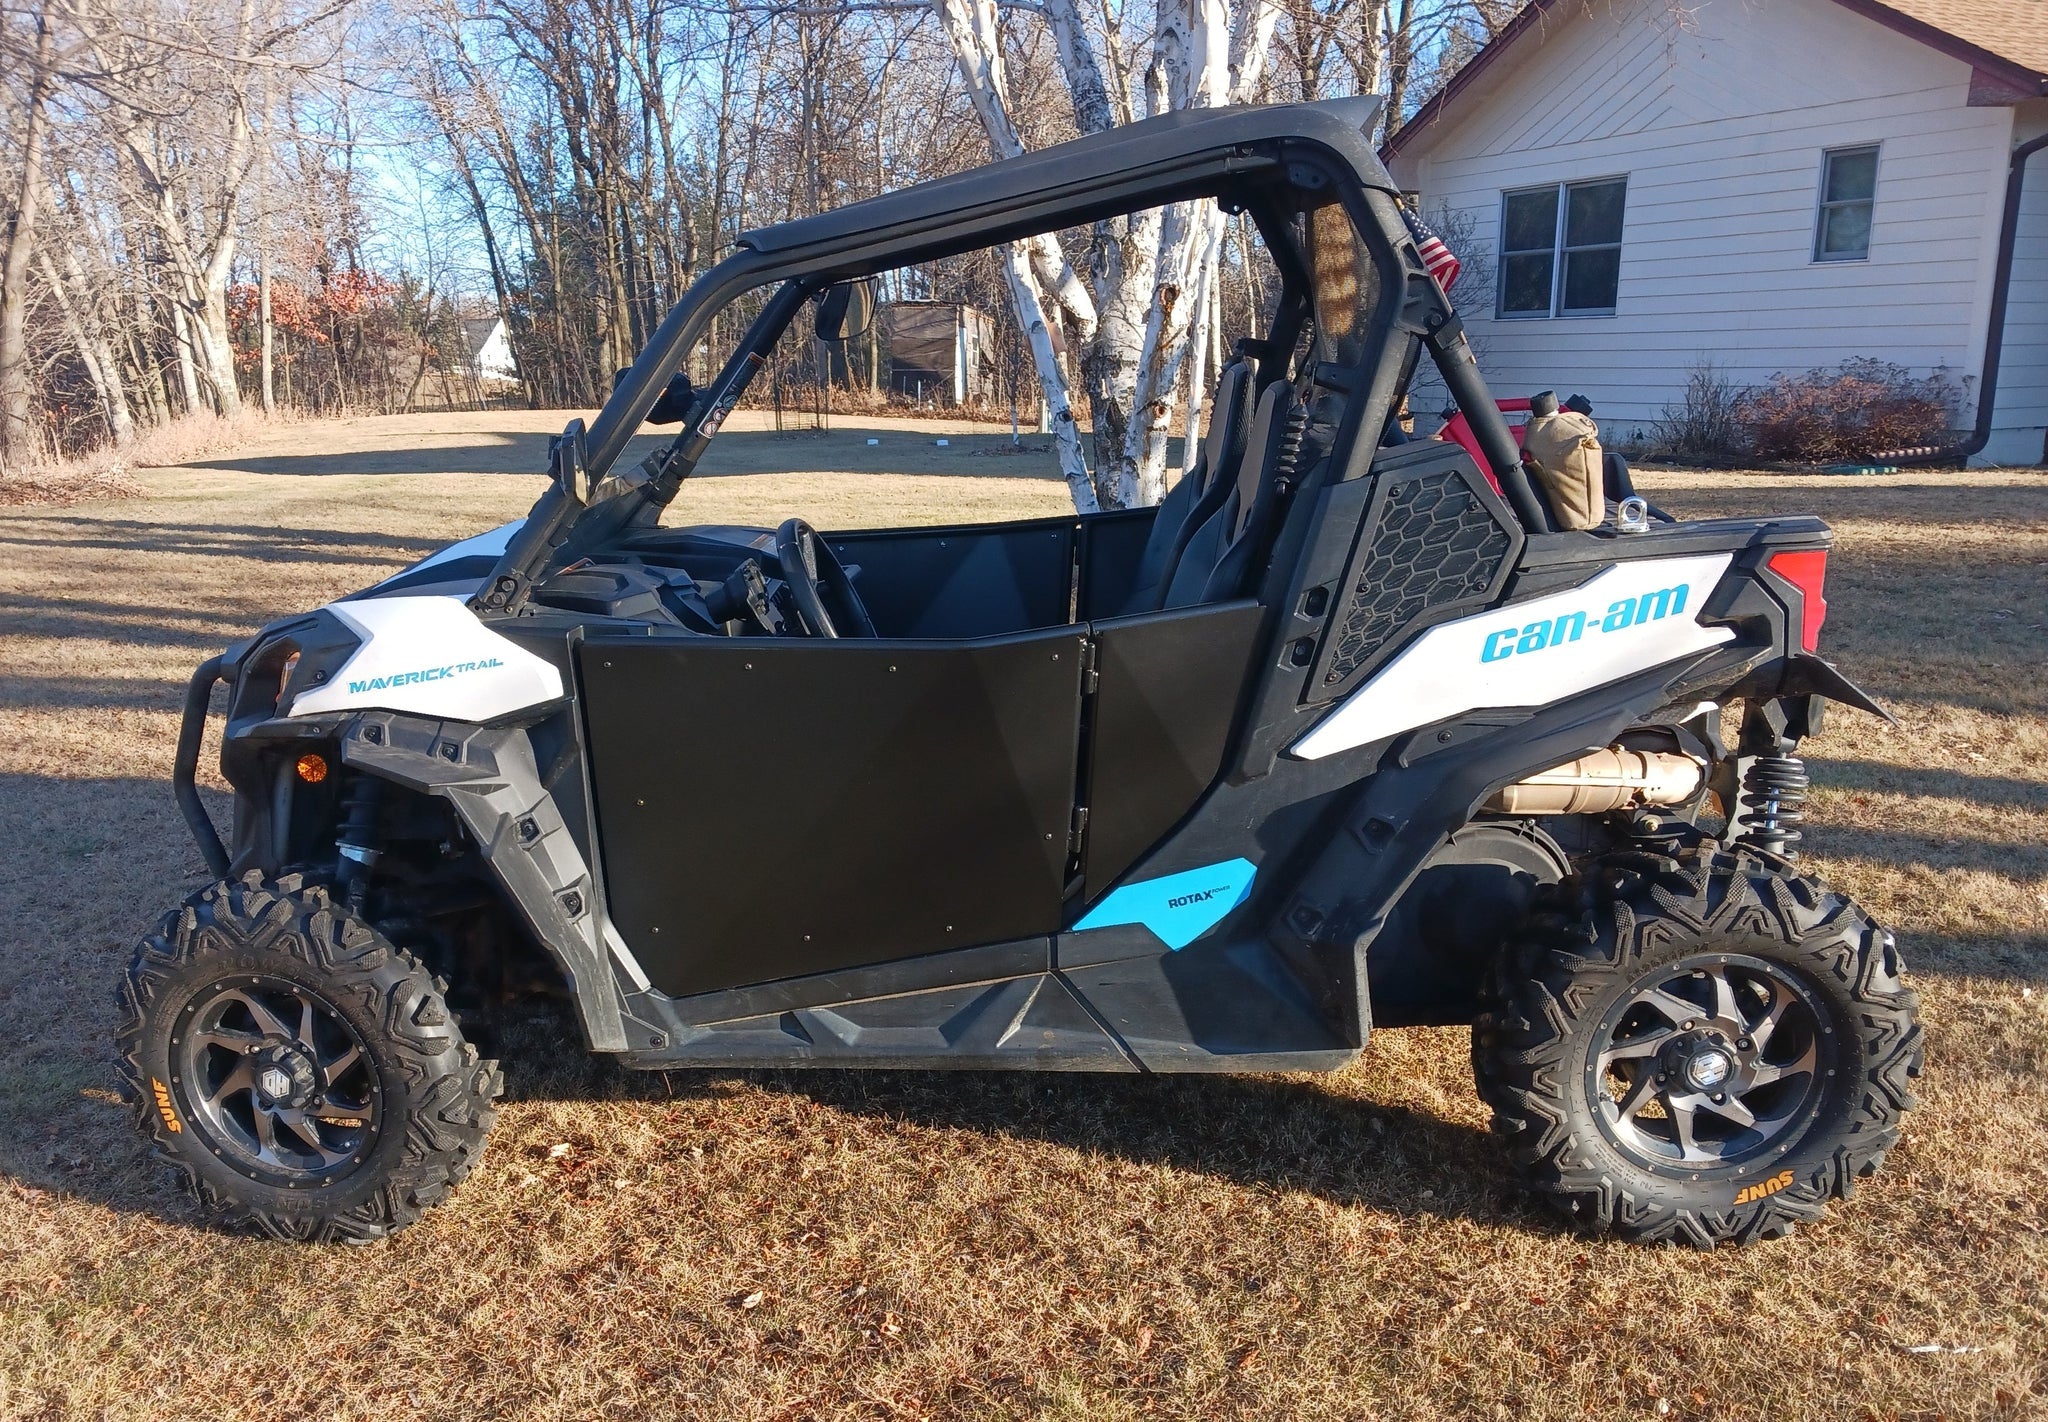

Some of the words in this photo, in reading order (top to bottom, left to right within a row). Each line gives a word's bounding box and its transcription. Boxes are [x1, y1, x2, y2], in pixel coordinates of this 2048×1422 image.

[1480, 583, 1690, 664] can-am
[348, 664, 455, 694] MAVERICK
[456, 658, 504, 673] TRAIL
[1168, 890, 1213, 909] ROTAX
[151, 1076, 182, 1135] SUNF
[1733, 1170, 1795, 1205] SUNF
